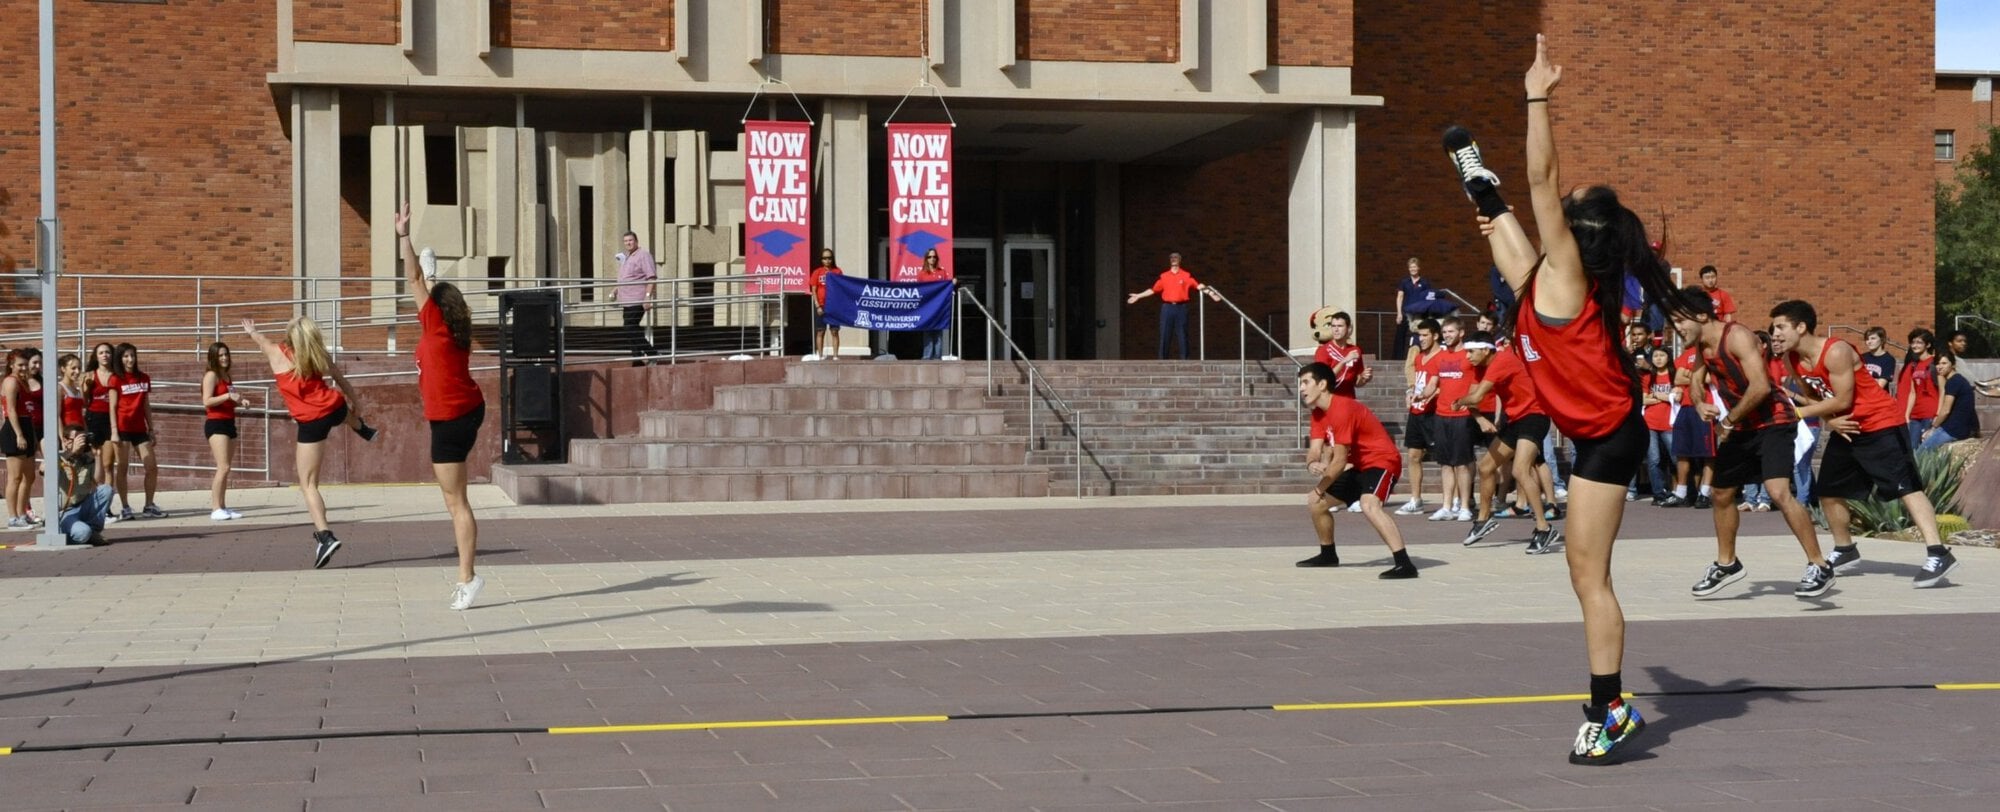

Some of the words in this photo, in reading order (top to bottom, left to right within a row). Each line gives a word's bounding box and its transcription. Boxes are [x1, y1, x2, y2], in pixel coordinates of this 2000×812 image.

[750, 131, 806, 157] NOW
[892, 133, 948, 159] NOW
[748, 158, 806, 195] WE
[891, 160, 948, 196] WE
[749, 196, 807, 225] CAN!
[892, 197, 950, 226] CAN!
[862, 284, 921, 298] ARIZONA
[861, 300, 920, 309] assurance
[871, 313, 883, 321] THE
[885, 314, 921, 322] UNIVERSITY
